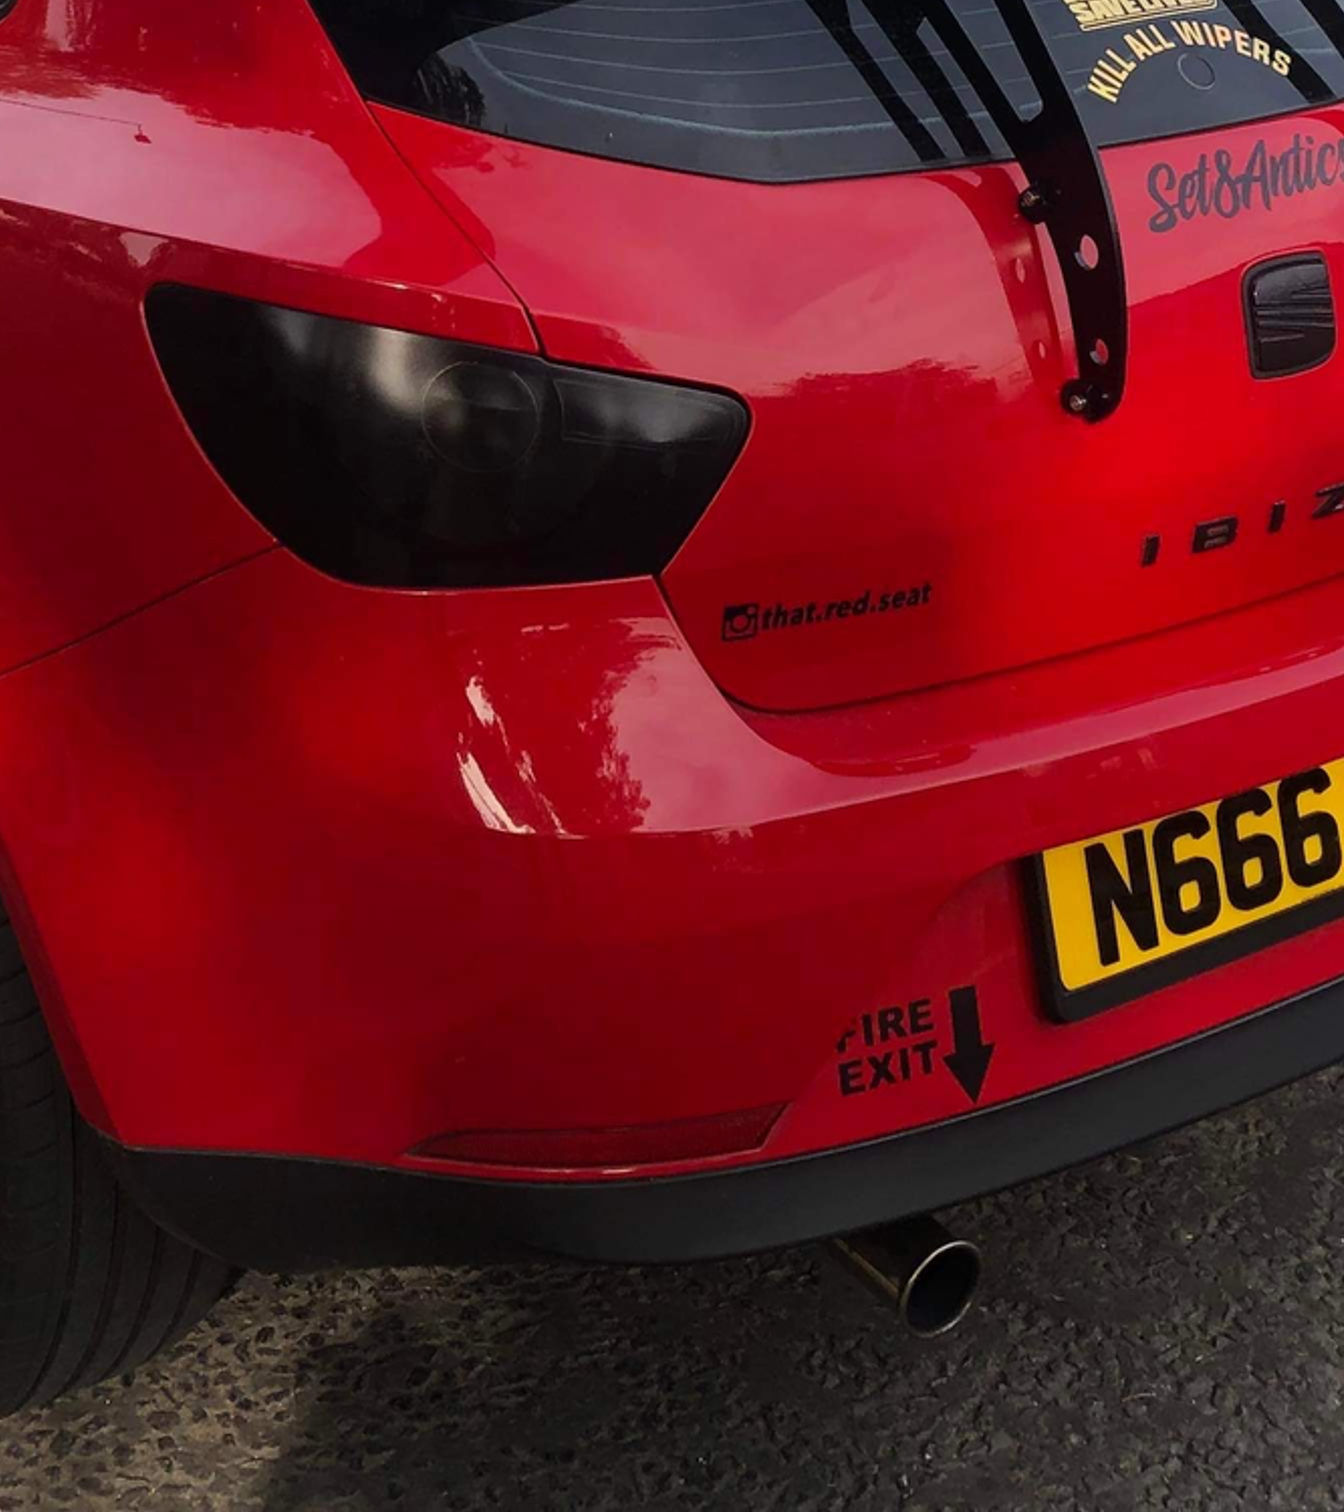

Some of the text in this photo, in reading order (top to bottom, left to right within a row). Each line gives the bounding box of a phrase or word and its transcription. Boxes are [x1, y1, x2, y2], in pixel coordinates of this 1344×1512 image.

[1087, 20, 1292, 103] KILL ALL WIPERS
[1084, 767, 1343, 968] N666
[838, 1039, 938, 1097] EXIT
